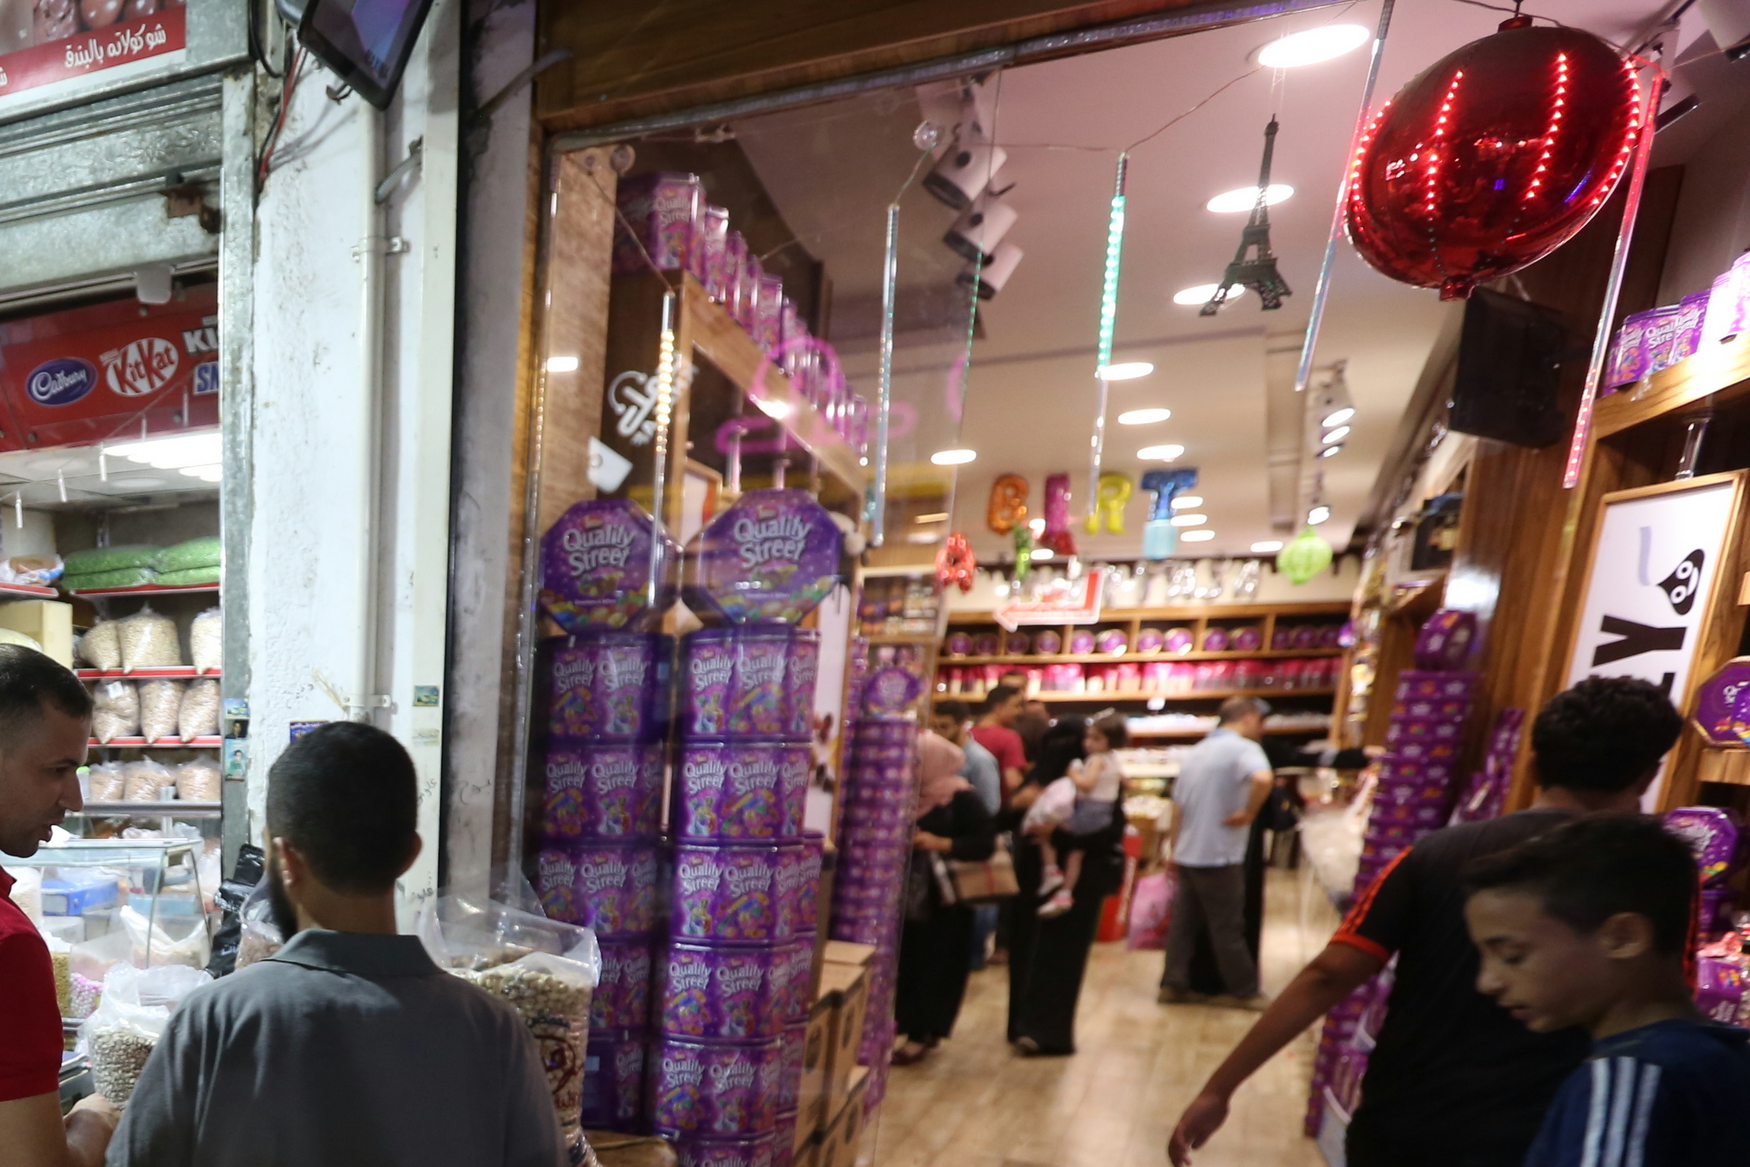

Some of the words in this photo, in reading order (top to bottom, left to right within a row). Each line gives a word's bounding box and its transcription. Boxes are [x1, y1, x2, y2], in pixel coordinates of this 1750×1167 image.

[63, 40, 105, 69] بالبندق
[112, 338, 176, 394] KitKat
[31, 368, 88, 400] Cadbury
[562, 524, 637, 552] Quality
[734, 515, 815, 545] Quality
[568, 547, 630, 577] Street
[740, 540, 807, 570] Street
[552, 658, 597, 678] Quality
[691, 657, 736, 677] Quality
[546, 762, 588, 781] Quality
[591, 761, 641, 782] Quality
[682, 762, 727, 781] Quality
[730, 762, 781, 781] Quality
[581, 860, 630, 880] Quality
[678, 862, 723, 882] Quality
[724, 864, 775, 884] Quality
[668, 961, 713, 981] Quality
[716, 962, 766, 983] Quality
[662, 1057, 706, 1077] Quality
[709, 1061, 758, 1081] Quality
